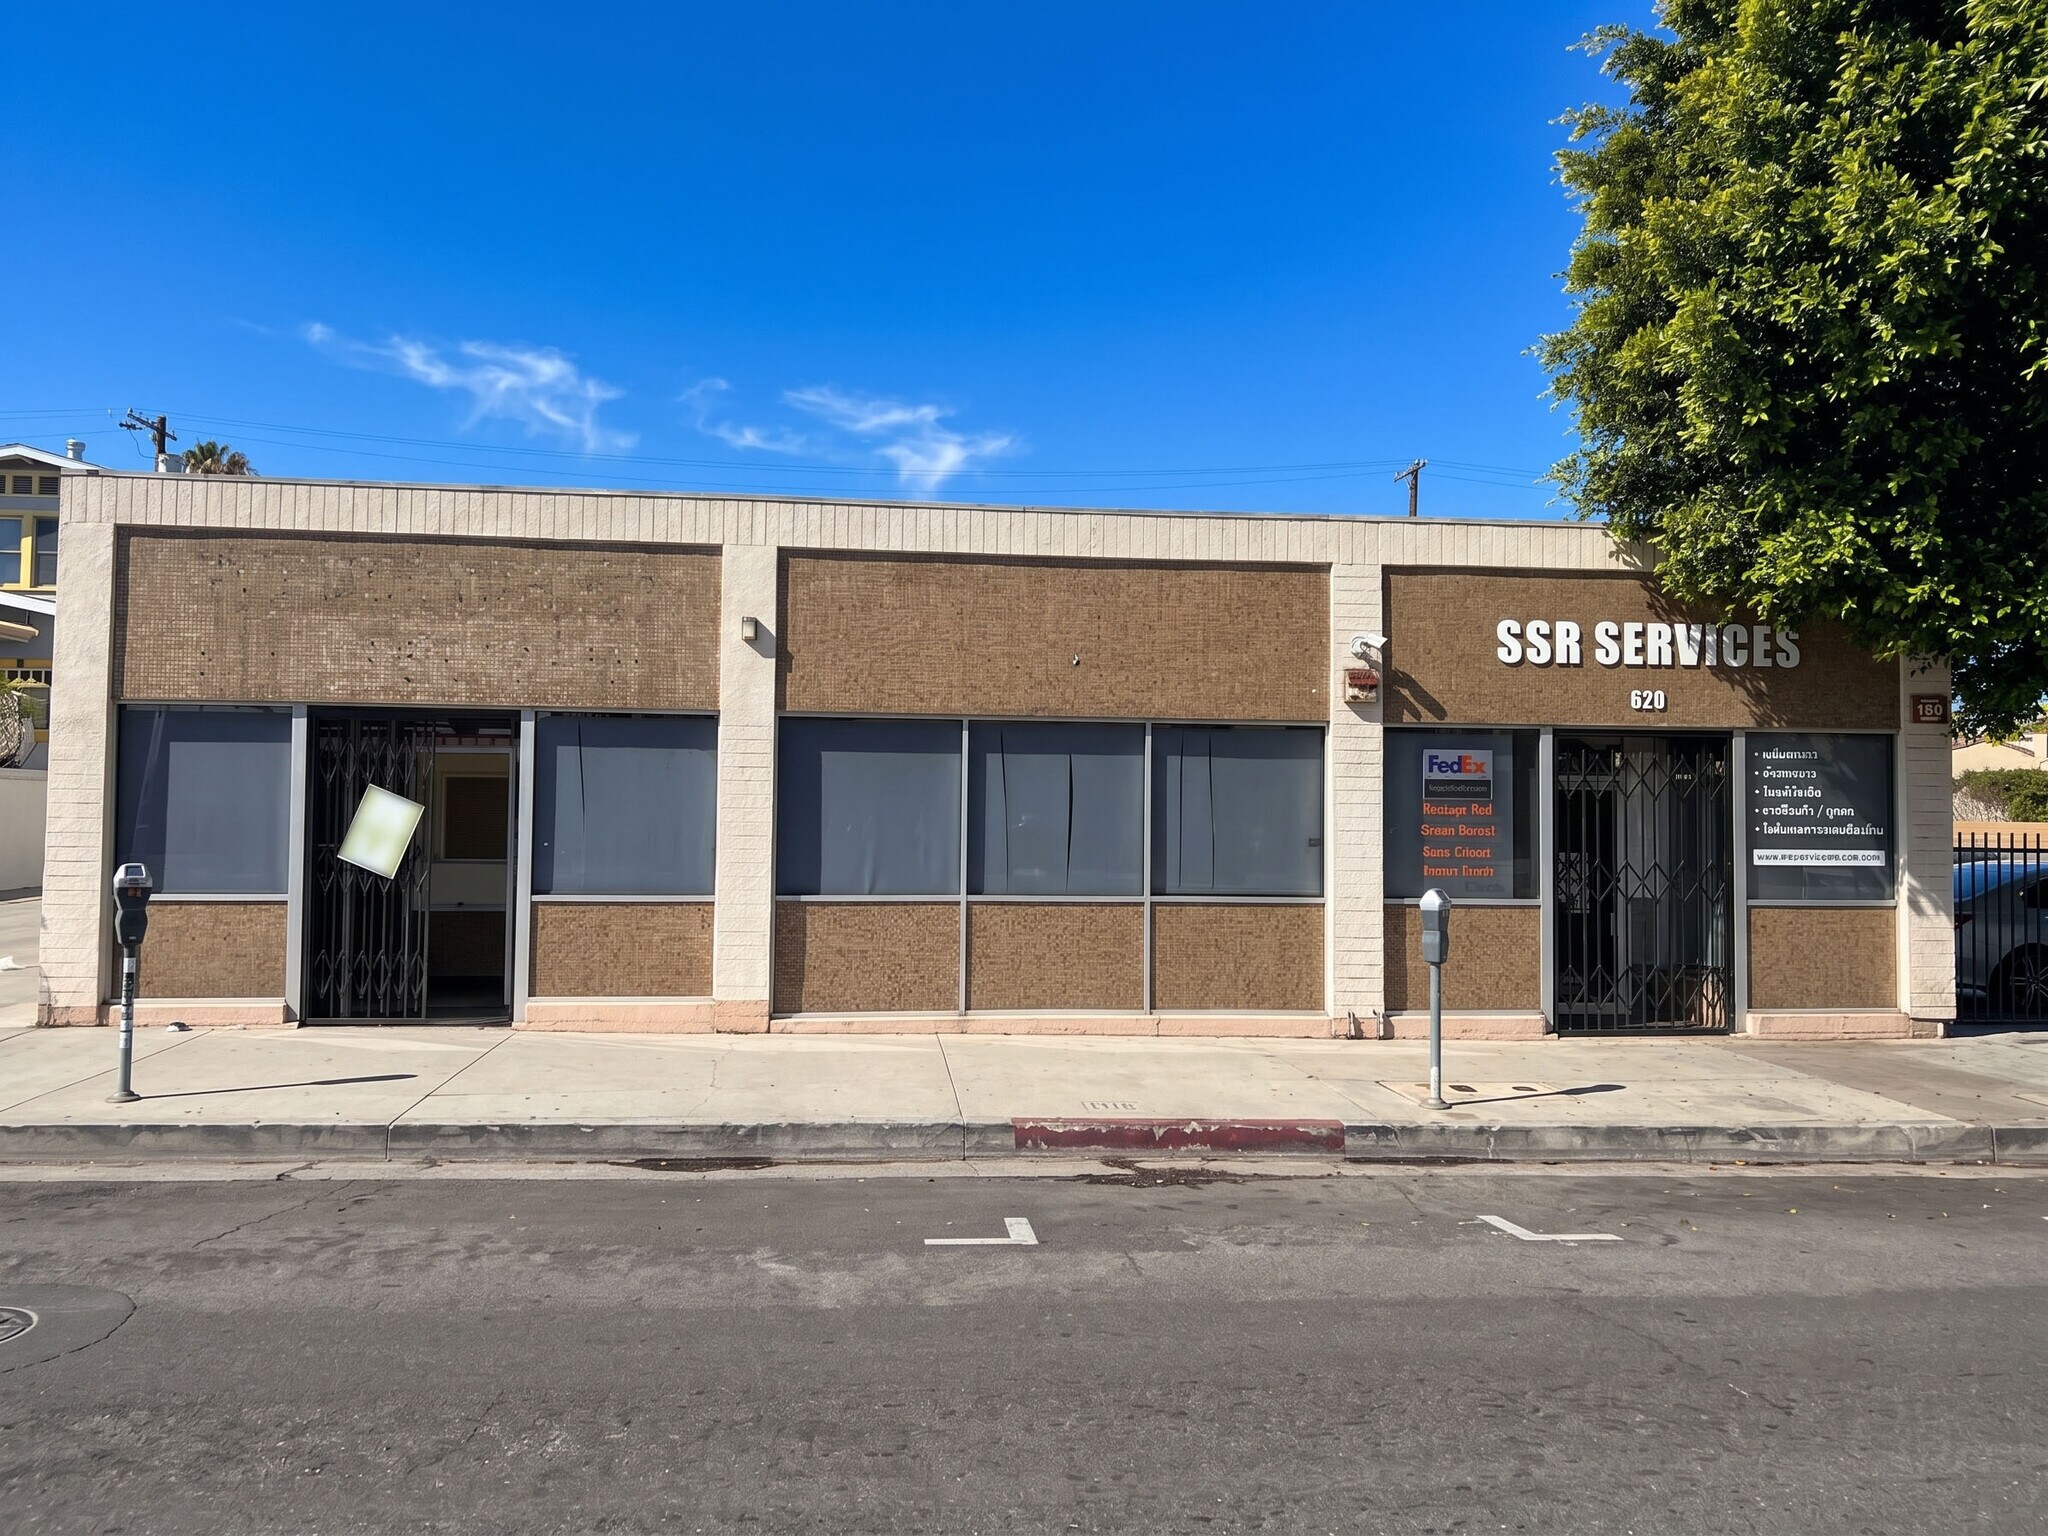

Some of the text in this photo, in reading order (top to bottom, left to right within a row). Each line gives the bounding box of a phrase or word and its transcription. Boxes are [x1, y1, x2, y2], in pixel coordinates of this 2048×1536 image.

[1496, 619, 1801, 669] SSR SERVICES
[1630, 690, 1666, 710] 620
[1428, 754, 1487, 774] FedEx
[1471, 803, 1492, 816] Red
